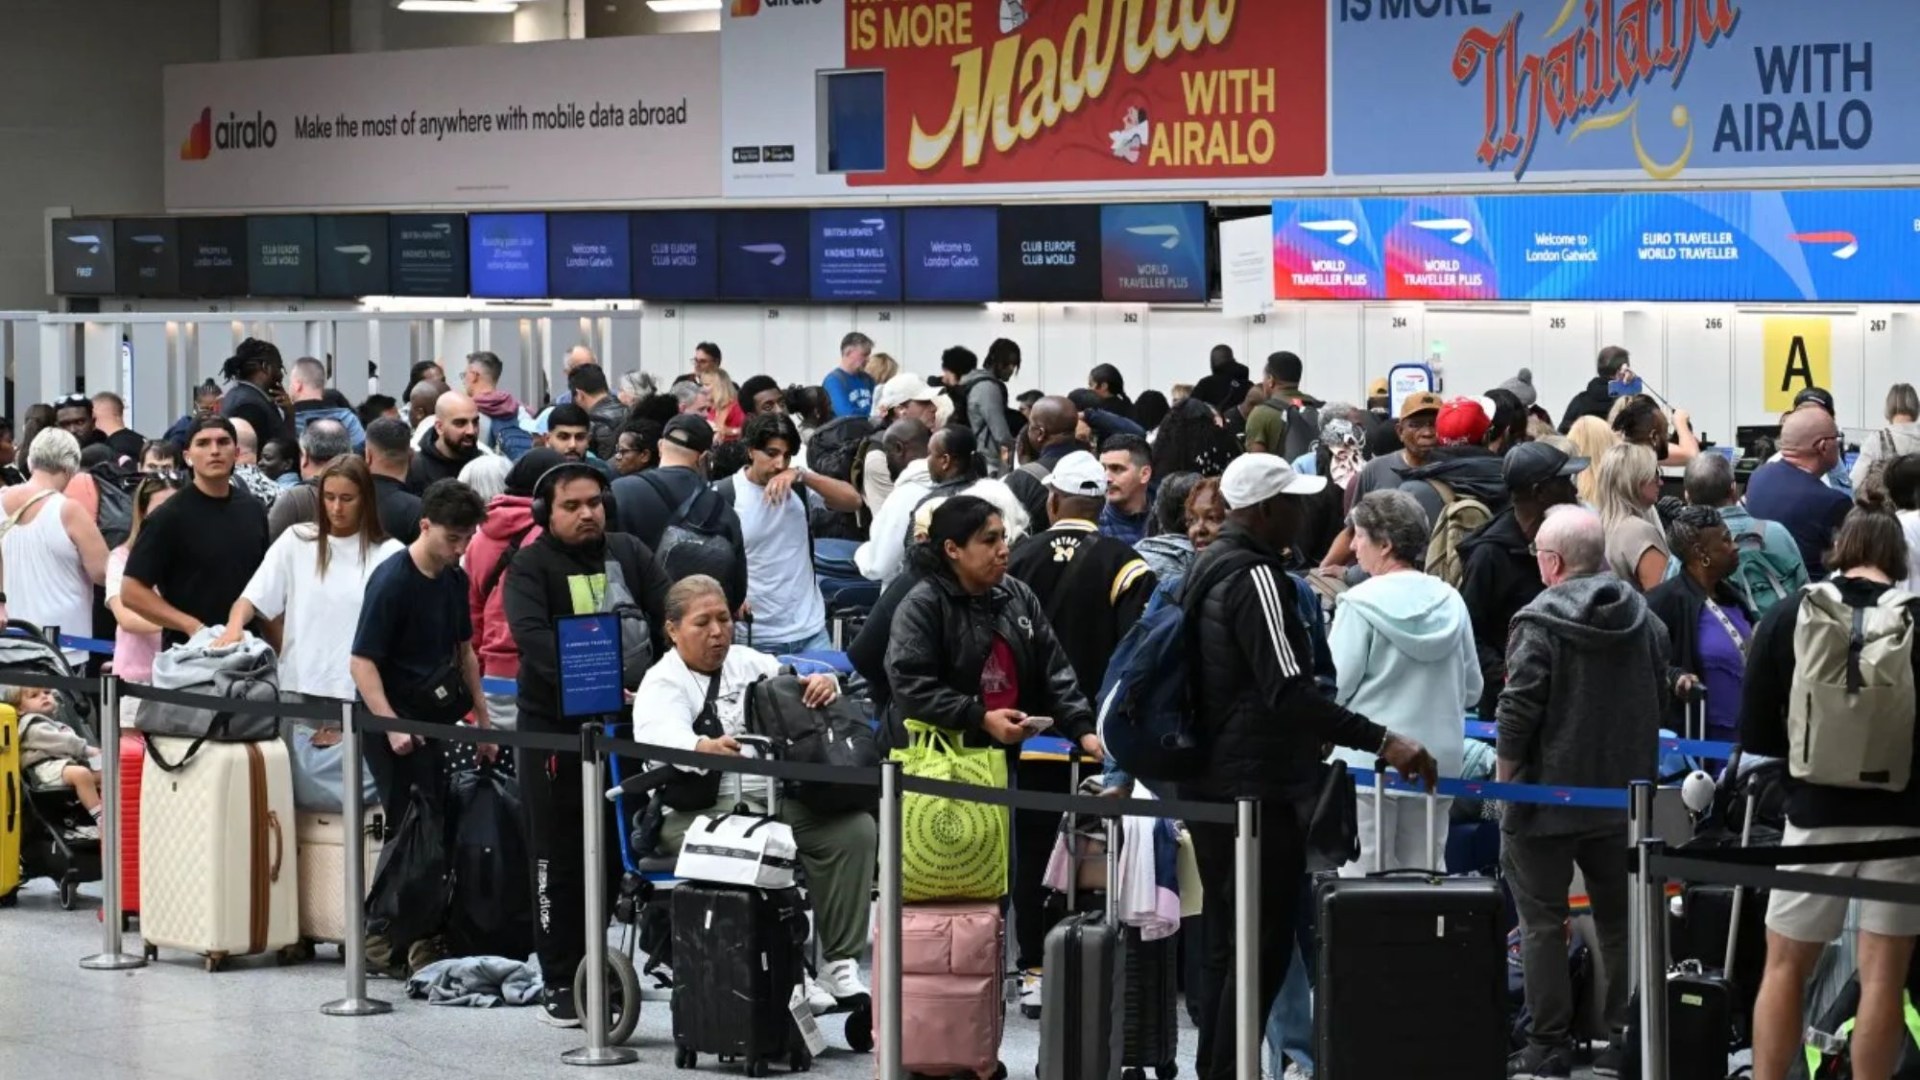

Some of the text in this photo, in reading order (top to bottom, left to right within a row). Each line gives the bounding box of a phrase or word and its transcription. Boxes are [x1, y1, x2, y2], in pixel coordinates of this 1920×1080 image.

[851, 2, 973, 50] IS MORE
[1755, 42, 1873, 95] WITH
[1181, 68, 1275, 115] WITH
[295, 97, 687, 141] Make the most of anywhere with mobile data abroad
[1712, 98, 1873, 152] AIRALO
[215, 110, 277, 149] airalo
[1148, 118, 1275, 166] AIRALO
[1535, 232, 1588, 246] Welcome to
[1642, 232, 1733, 245] EURO TRAVELLER
[571, 243, 607, 254] Welcome to
[651, 243, 697, 254] CLUB EUROPE
[930, 240, 972, 252] Welcome to
[1021, 241, 1076, 253] CLUB EUROPE
[855, 248, 884, 258] TRAVELS
[1526, 247, 1599, 262] London Gatwick
[1638, 247, 1738, 260] WORLD TRAVELLER
[566, 257, 589, 268] London
[652, 255, 697, 266] CLUB WORLD
[923, 255, 980, 268] London Gatwick
[1022, 254, 1076, 266] CLUB WORLD
[1311, 260, 1346, 272] WORLD
[1424, 260, 1460, 272] WORLD
[1136, 265, 1169, 275] WORLD
[1118, 277, 1189, 289] TRAVELLER PLUS
[1291, 274, 1367, 286] TRAVELLER PLUS
[1403, 274, 1483, 286] TRAVELLER PLUS
[1002, 313, 1015, 323] 261
[1124, 313, 1138, 323] 262
[1392, 317, 1407, 328] 264
[1549, 317, 1566, 329] 265
[1705, 317, 1723, 330] 266
[1870, 319, 1886, 332] 267
[1781, 335, 1814, 391] A
